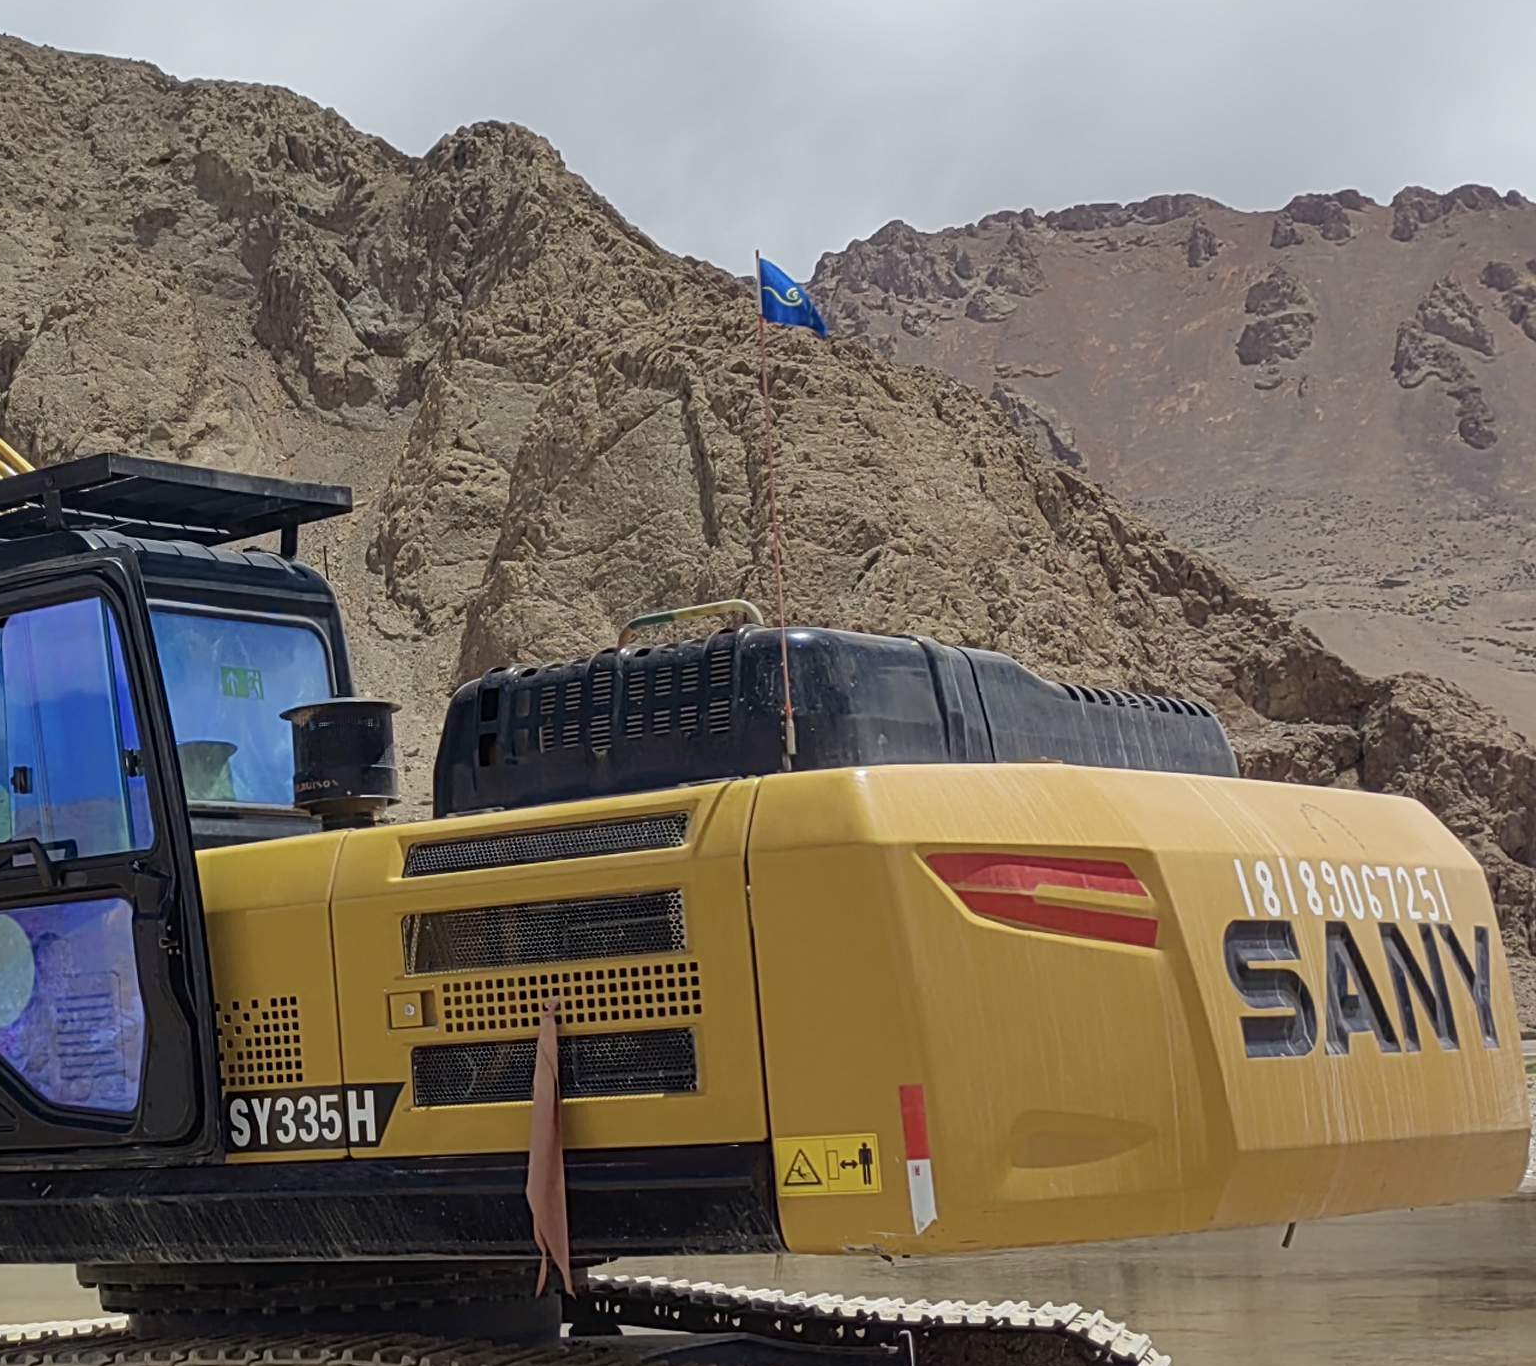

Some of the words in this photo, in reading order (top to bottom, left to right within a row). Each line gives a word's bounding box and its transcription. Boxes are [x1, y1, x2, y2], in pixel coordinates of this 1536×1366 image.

[1233, 857, 1453, 921] 18189067251
[1223, 919, 1500, 1059] SANY
[229, 1089, 377, 1147] SY335H
